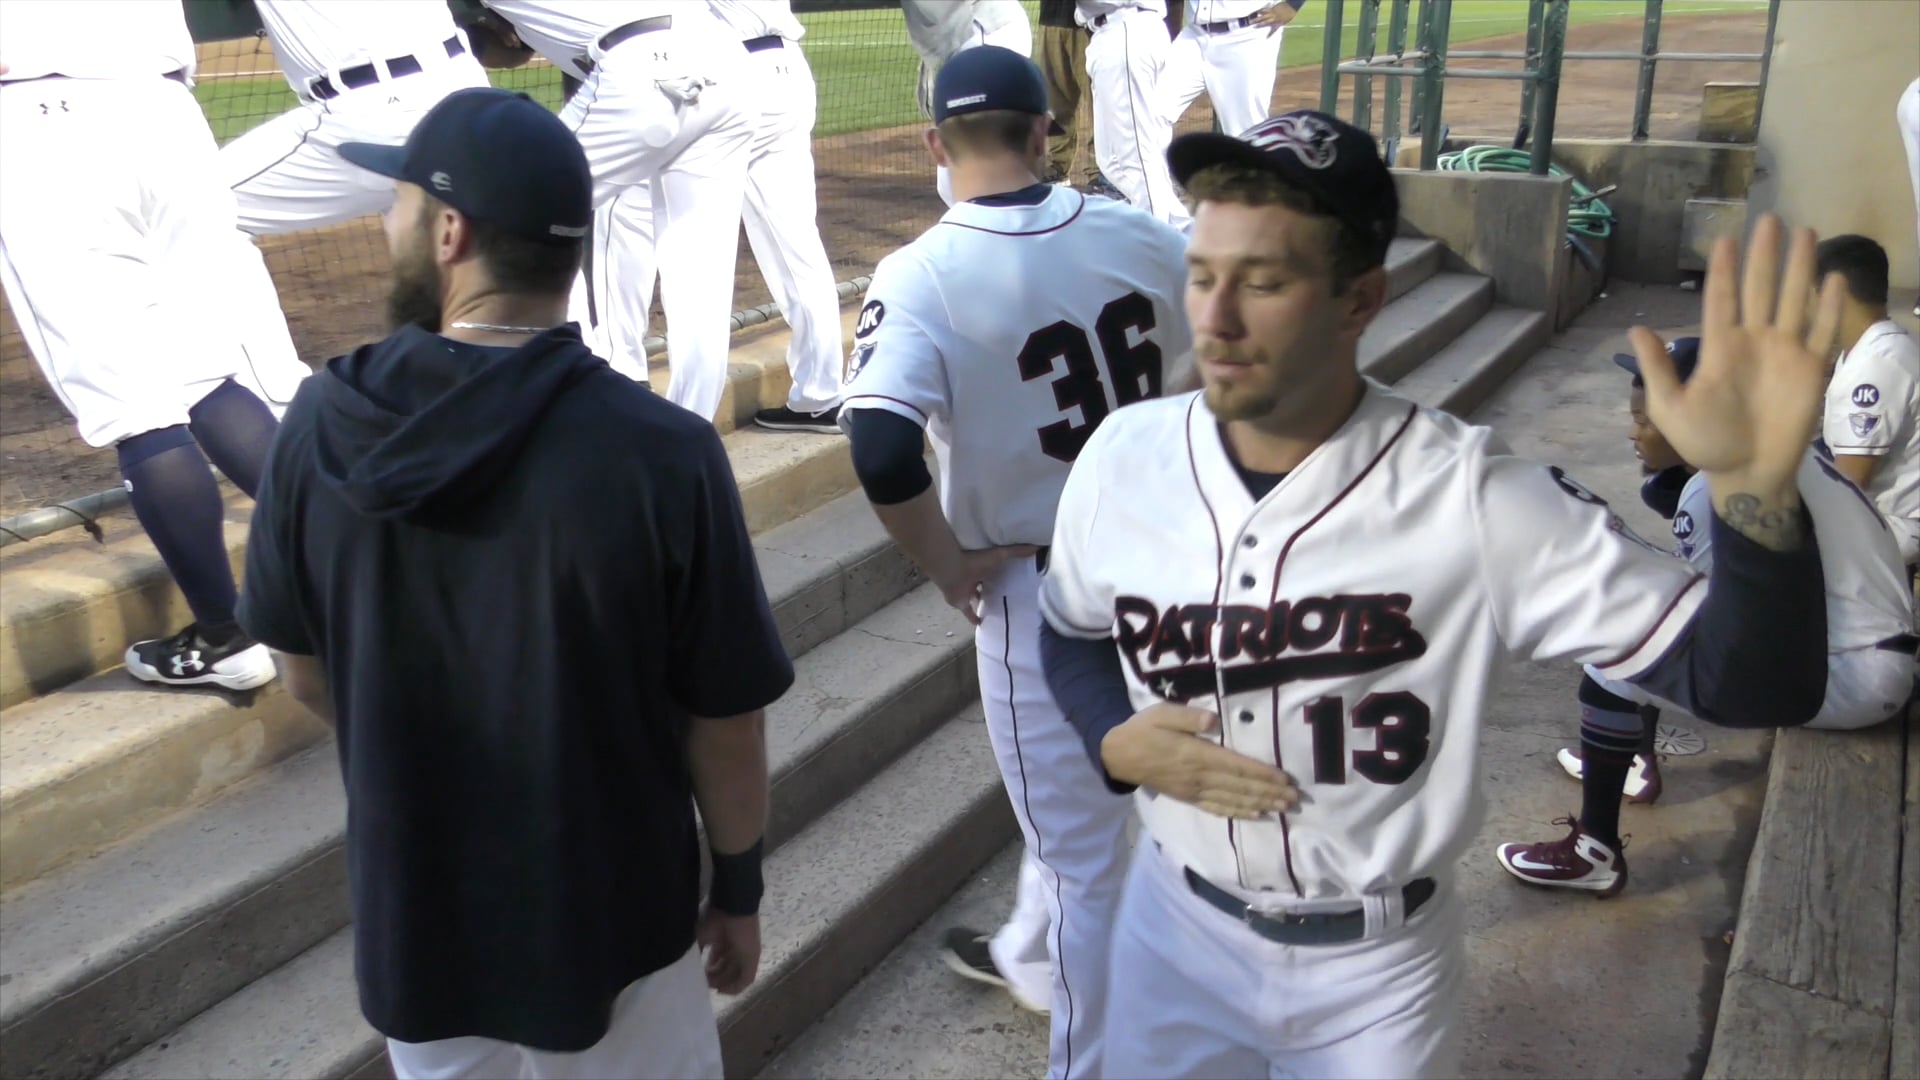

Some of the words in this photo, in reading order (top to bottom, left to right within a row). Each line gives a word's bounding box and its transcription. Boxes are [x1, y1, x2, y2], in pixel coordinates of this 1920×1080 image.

[856, 305, 882, 334] JK
[1017, 291, 1162, 463] 36
[1852, 387, 1876, 403] JK
[1673, 515, 1691, 534] JK
[1114, 594, 1426, 684] PATRIOTS
[1303, 690, 1431, 784] 13
